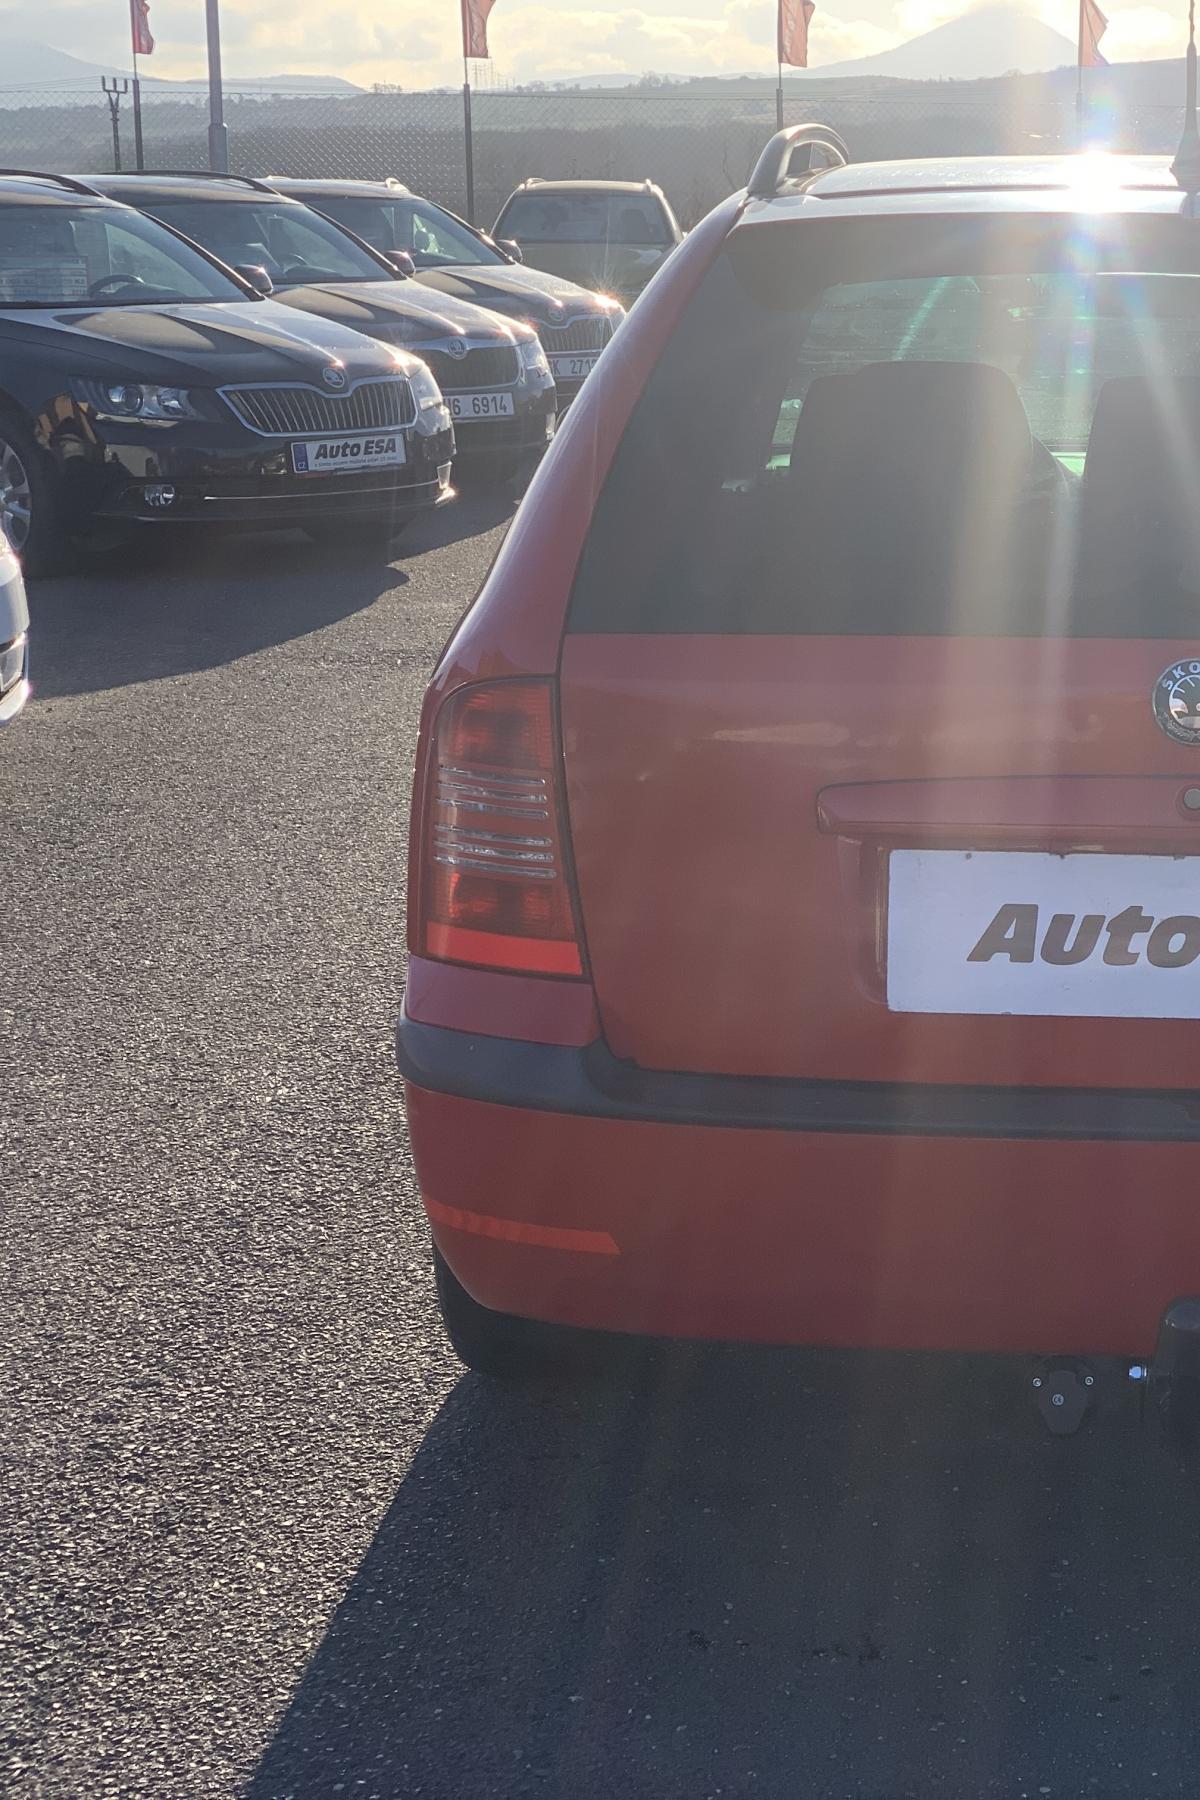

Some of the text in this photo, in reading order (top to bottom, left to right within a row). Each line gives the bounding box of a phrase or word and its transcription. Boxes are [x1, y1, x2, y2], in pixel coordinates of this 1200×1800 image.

[472, 392, 507, 415] 6914
[314, 438, 397, 460] Auto ESA
